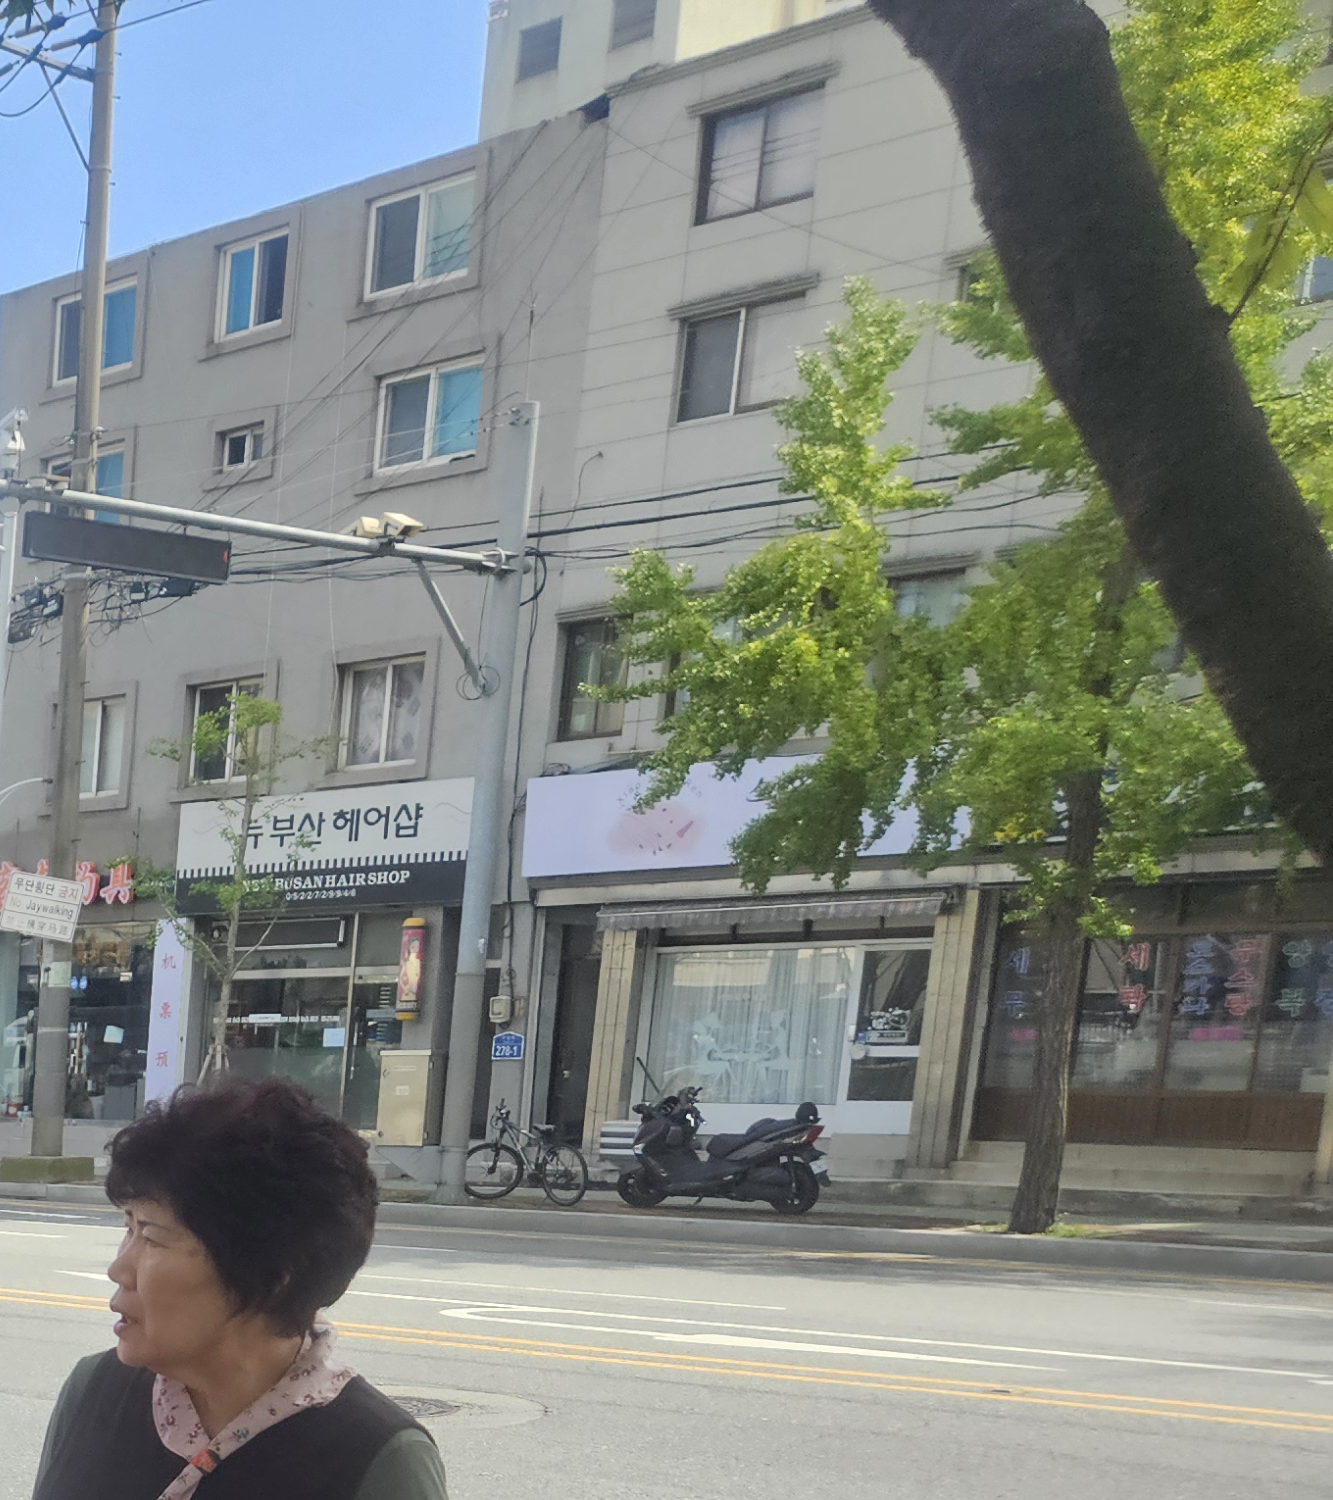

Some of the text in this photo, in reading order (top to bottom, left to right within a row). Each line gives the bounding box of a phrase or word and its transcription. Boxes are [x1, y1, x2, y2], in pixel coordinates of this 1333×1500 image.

[332, 802, 424, 842] 헤어샵
[14, 877, 79, 900] 무단횡단 금지
[325, 872, 366, 888] HAIR
[367, 870, 410, 885] SHOP
[9, 896, 73, 920] No Jaywalking
